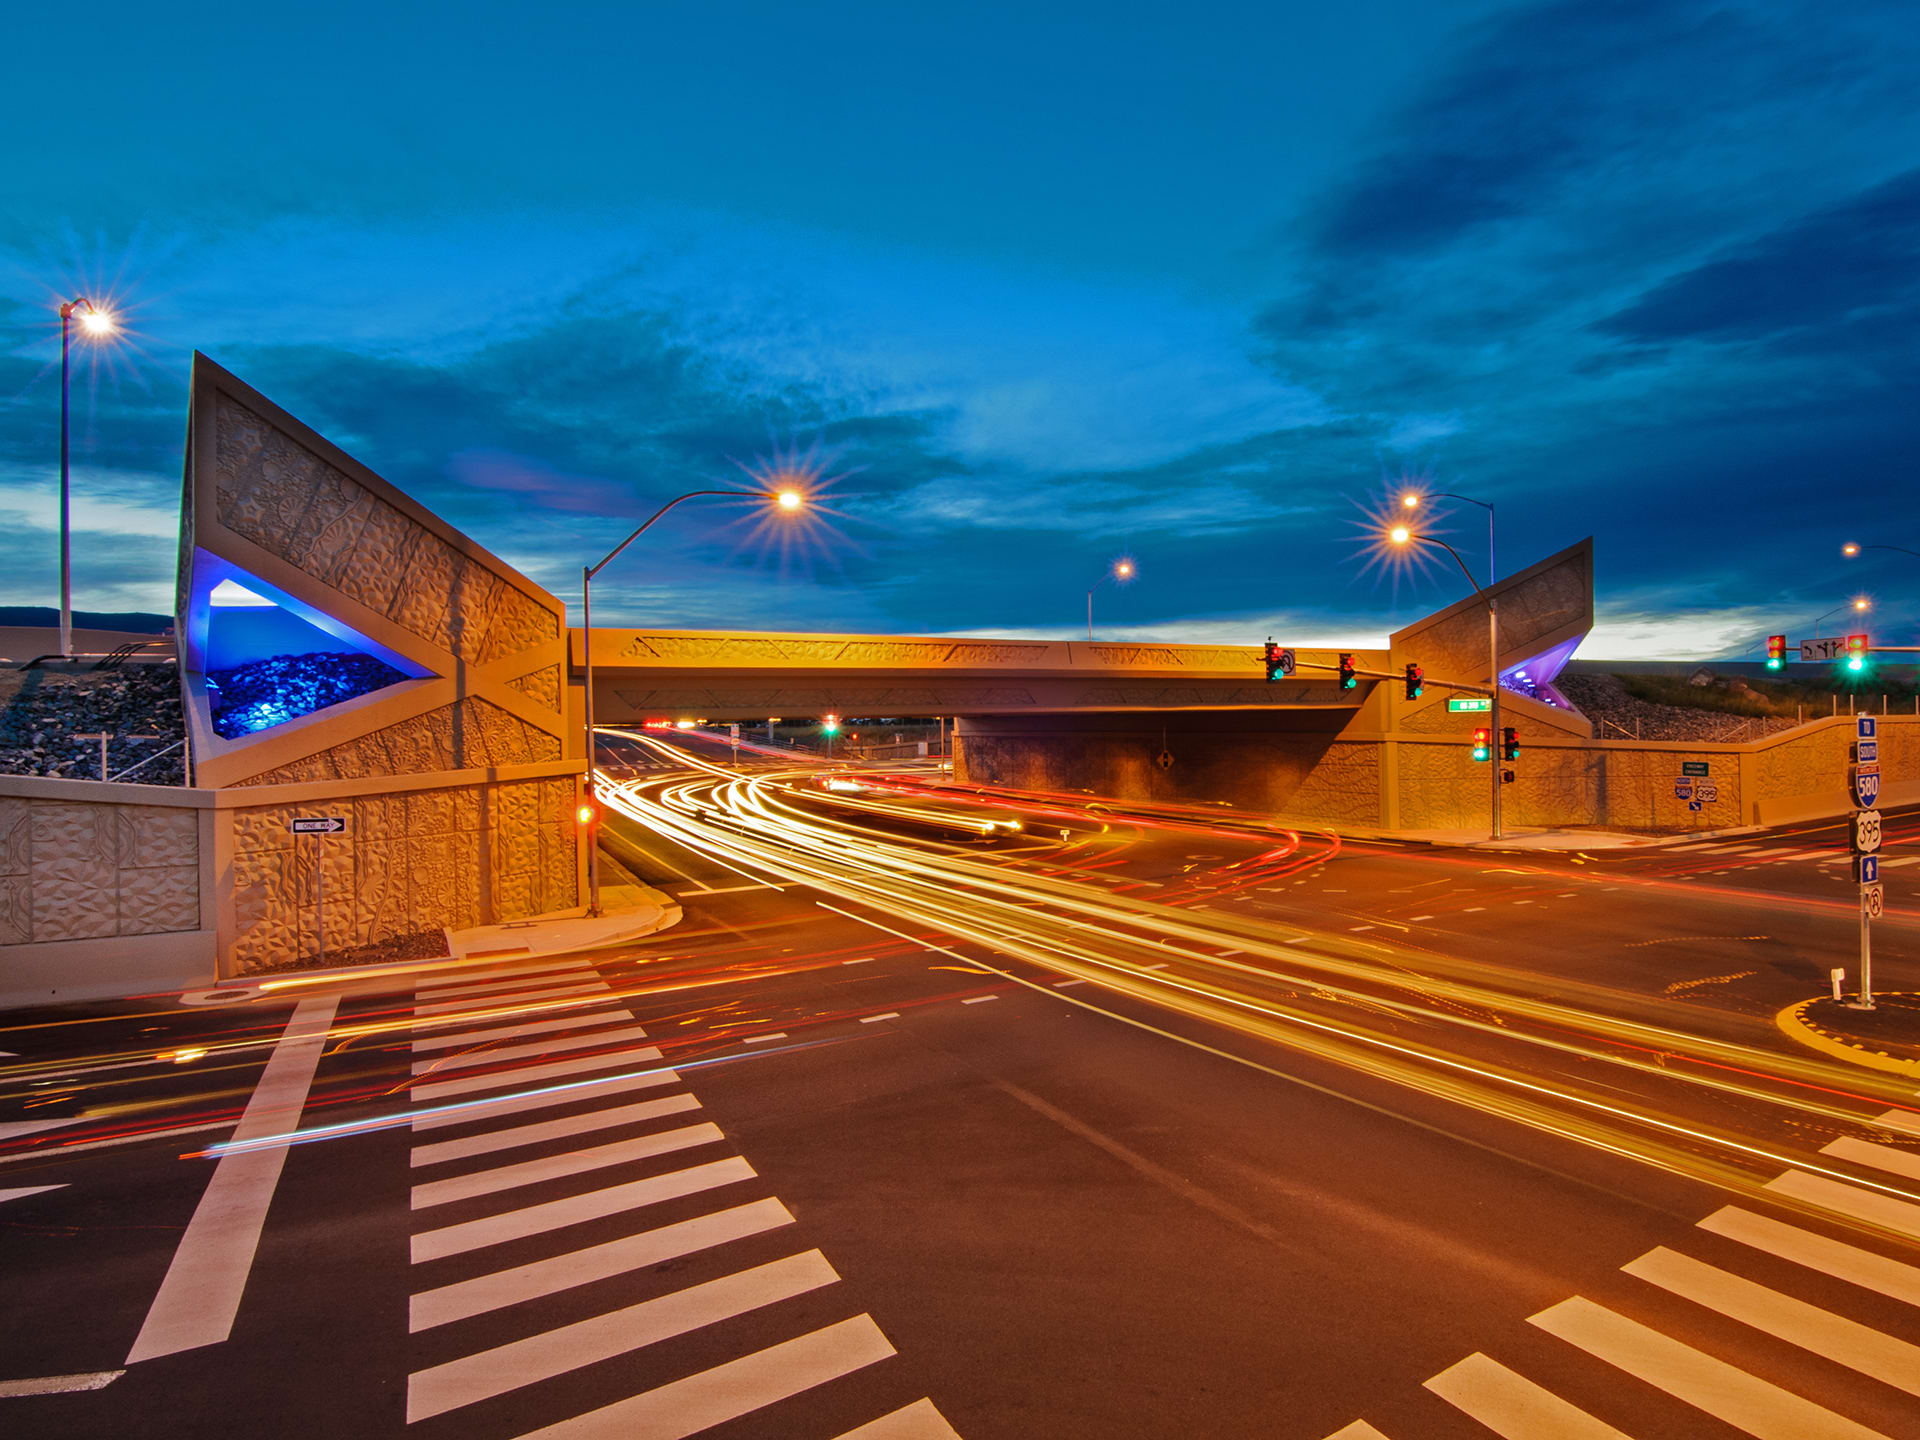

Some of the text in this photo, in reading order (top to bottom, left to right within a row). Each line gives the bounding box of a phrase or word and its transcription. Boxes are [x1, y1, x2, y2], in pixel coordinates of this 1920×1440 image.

[1863, 721, 1870, 734] TO
[1860, 746, 1876, 758] SOUTH
[1859, 775, 1878, 797] 580
[1676, 788, 1691, 797] 580
[1699, 790, 1715, 799] 395
[1860, 820, 1879, 844] 395
